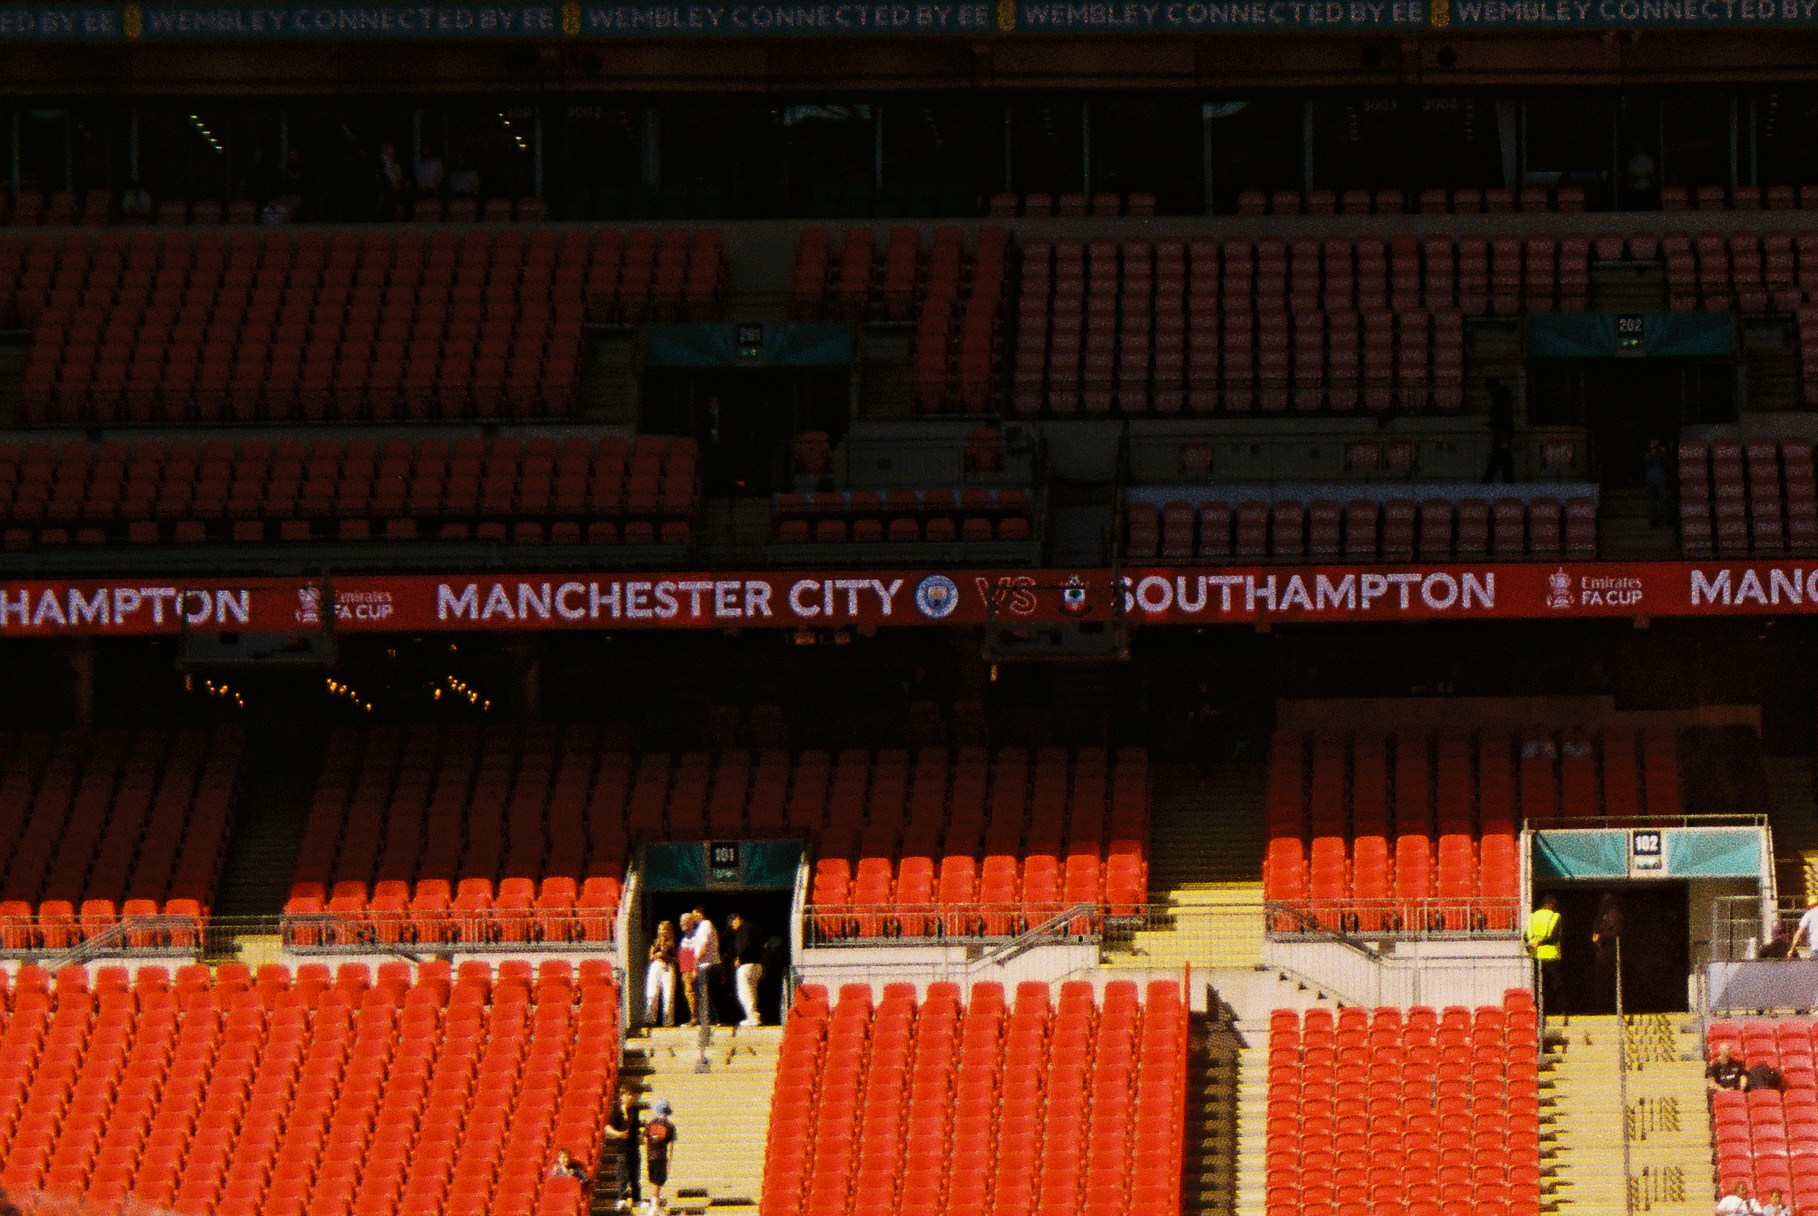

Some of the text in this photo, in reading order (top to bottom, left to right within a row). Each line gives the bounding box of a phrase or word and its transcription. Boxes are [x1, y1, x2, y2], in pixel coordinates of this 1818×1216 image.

[151, 8, 553, 32] WEMBLEY CONNECTED BY EE
[590, 6, 988, 30] WEMBLEY CONNECTED BY EE
[1025, 3, 1423, 25] WEMBLEY CONNECTED BY EE
[1457, 2, 1591, 22] WEMBLEY
[1601, 1, 1775, 21] CONNECTED
[1782, 1, 1816, 20] BY
[41, 11, 74, 32] BY
[84, 11, 115, 32] EE
[1618, 318, 1642, 332] 202
[1581, 577, 1642, 590] Emirates
[437, 580, 773, 622] MANCHESTER
[787, 578, 904, 618] CITY
[1581, 591, 1642, 607] FA CUP
[355, 603, 394, 620] CUP
[1635, 835, 1658, 851] 102
[714, 848, 735, 862] 101
